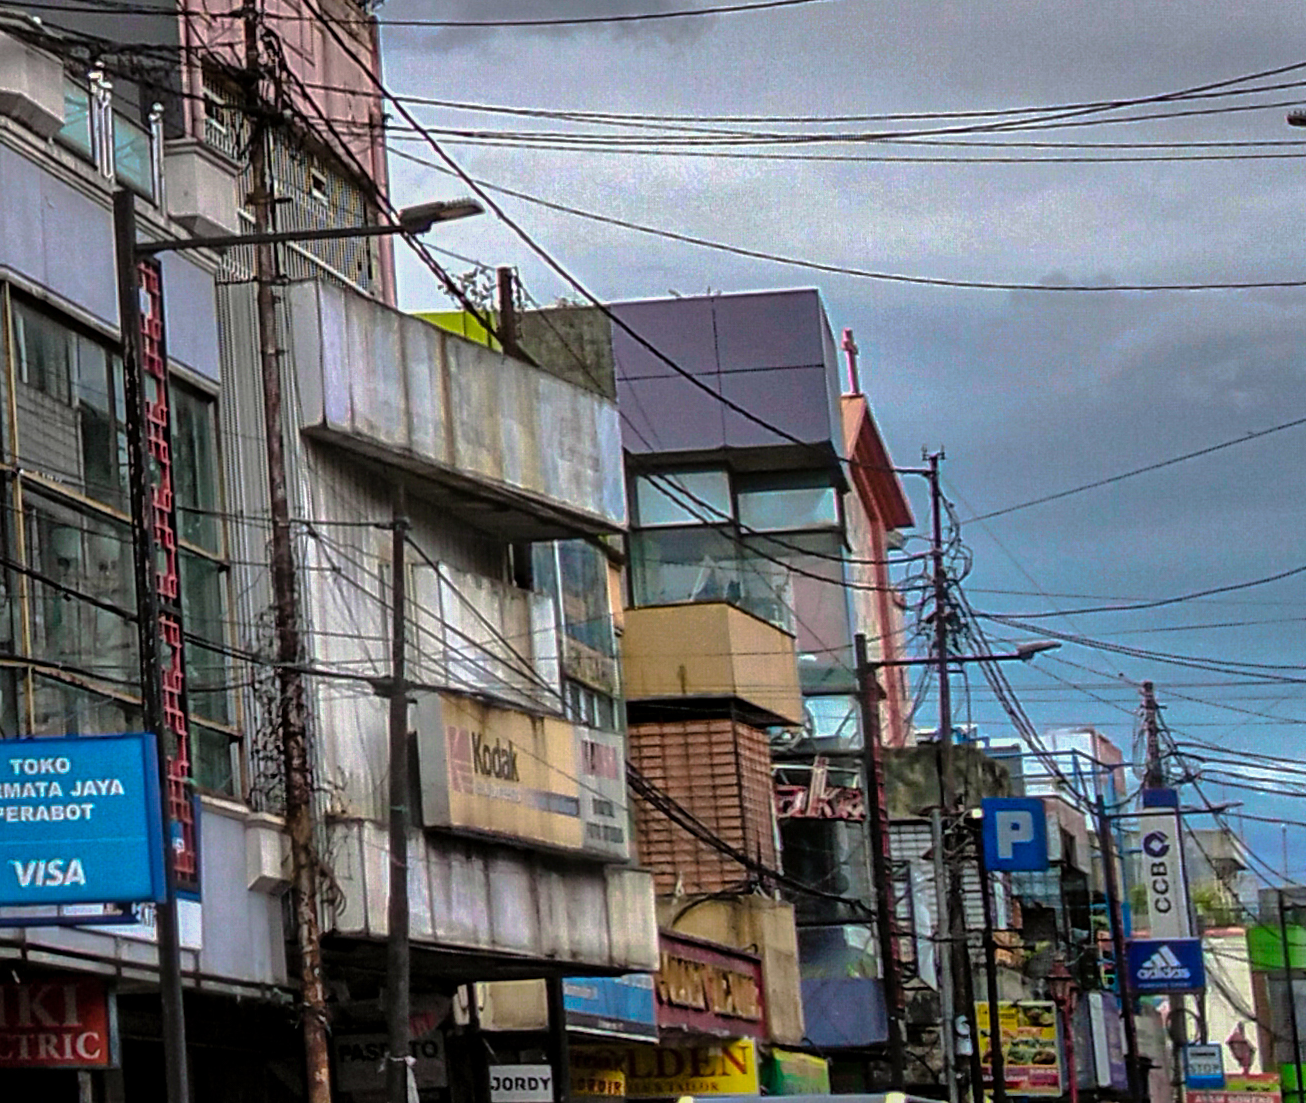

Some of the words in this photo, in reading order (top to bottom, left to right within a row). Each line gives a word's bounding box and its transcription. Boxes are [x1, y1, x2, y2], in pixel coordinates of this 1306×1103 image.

[9, 757, 71, 775] TOKO
[471, 731, 520, 782] Kodak
[70, 779, 124, 797] JAYA
[995, 810, 1035, 859] P
[7, 858, 86, 887] VISA
[1151, 861, 1172, 914] CCB
[491, 1076, 551, 1092] JORDY
